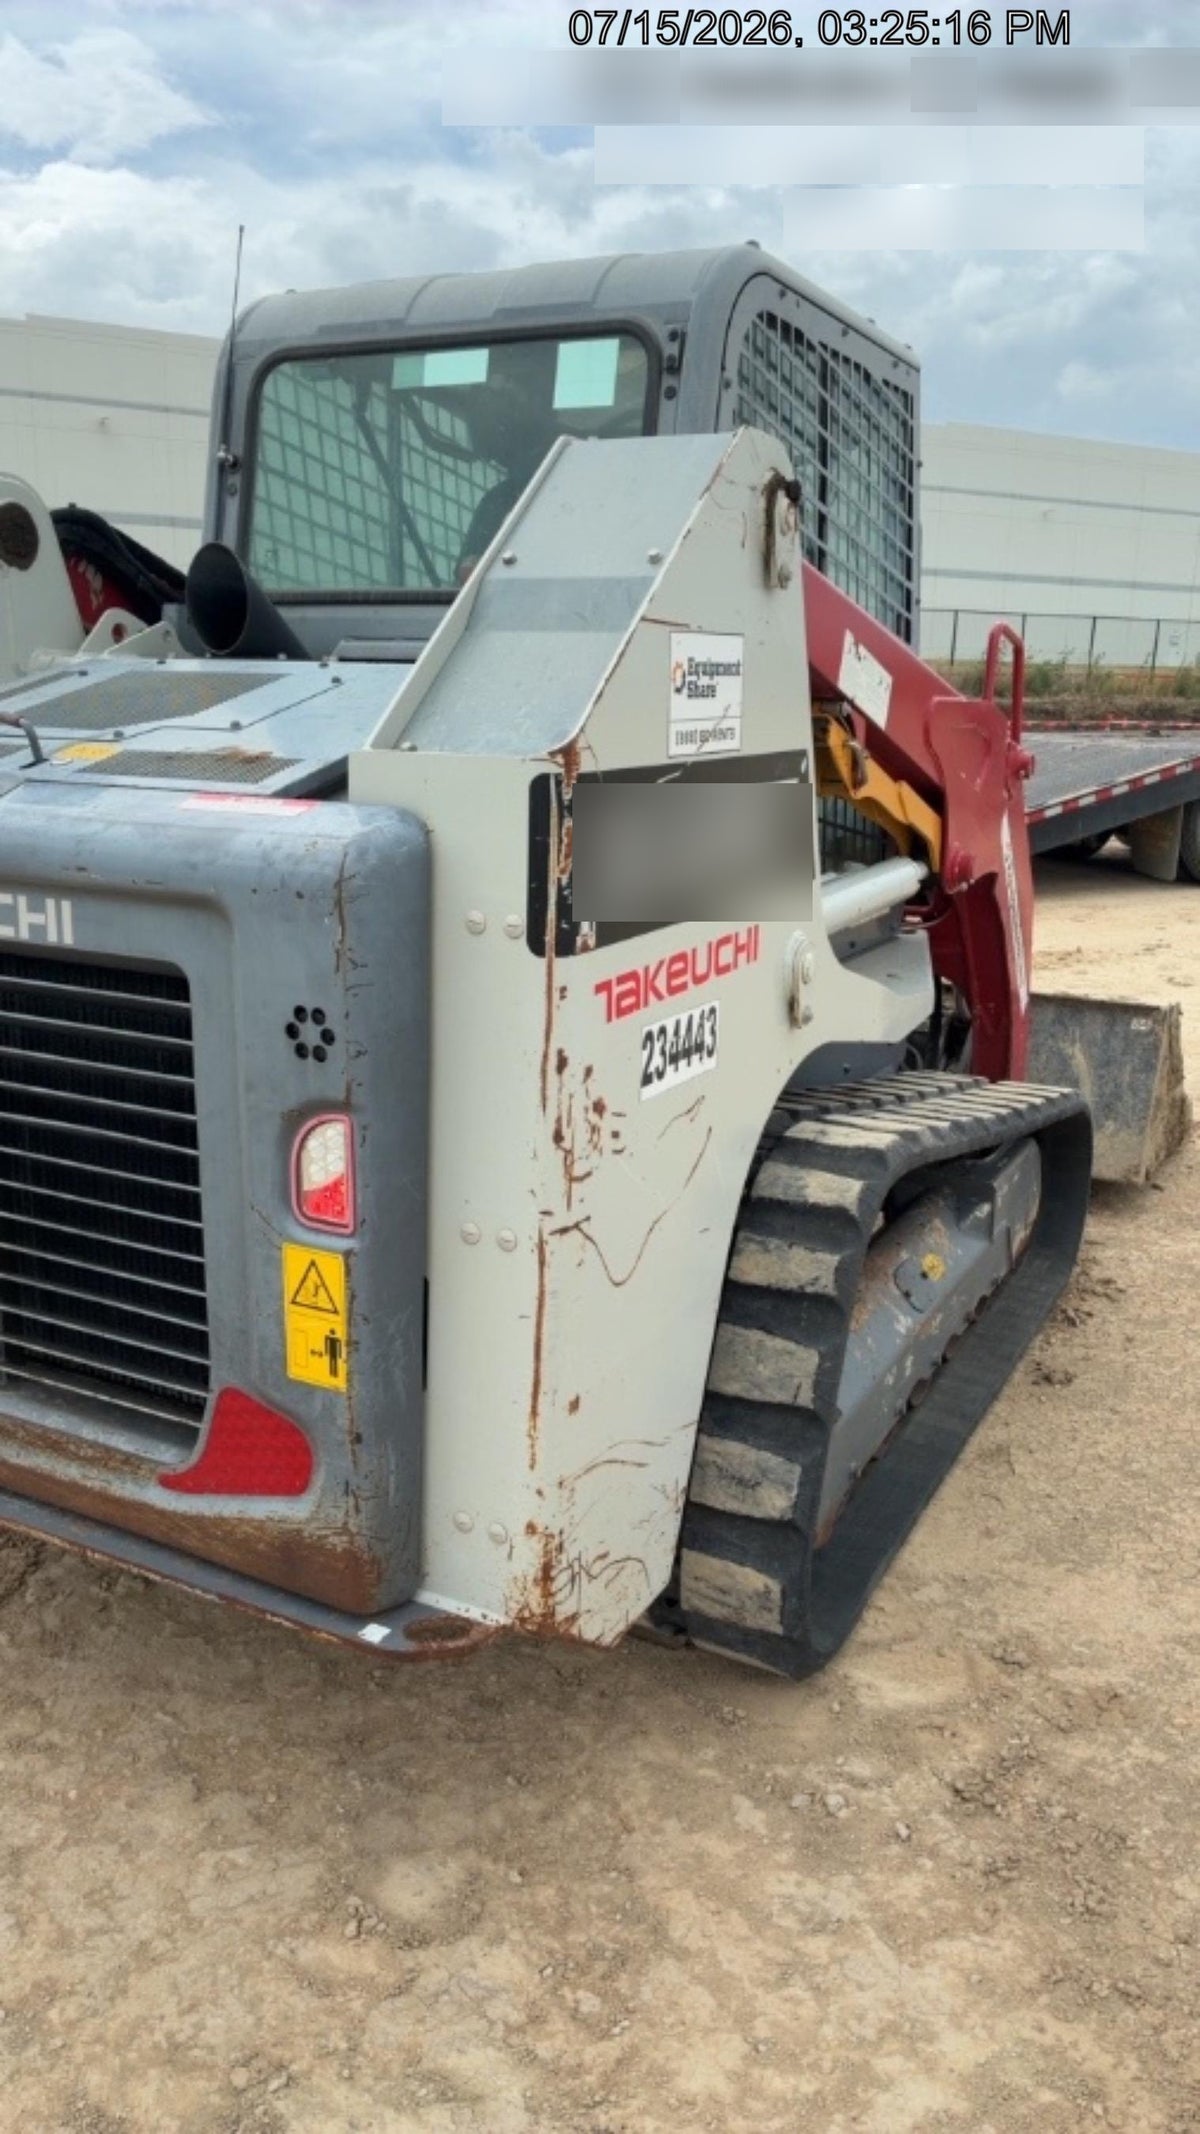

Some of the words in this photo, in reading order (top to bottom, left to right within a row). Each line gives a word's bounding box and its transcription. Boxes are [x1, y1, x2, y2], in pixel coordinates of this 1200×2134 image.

[687, 657, 741, 680] Equipment
[687, 681, 717, 699] Share
[594, 924, 760, 1024] TAKEUCHI
[640, 1005, 718, 1088] 234443
